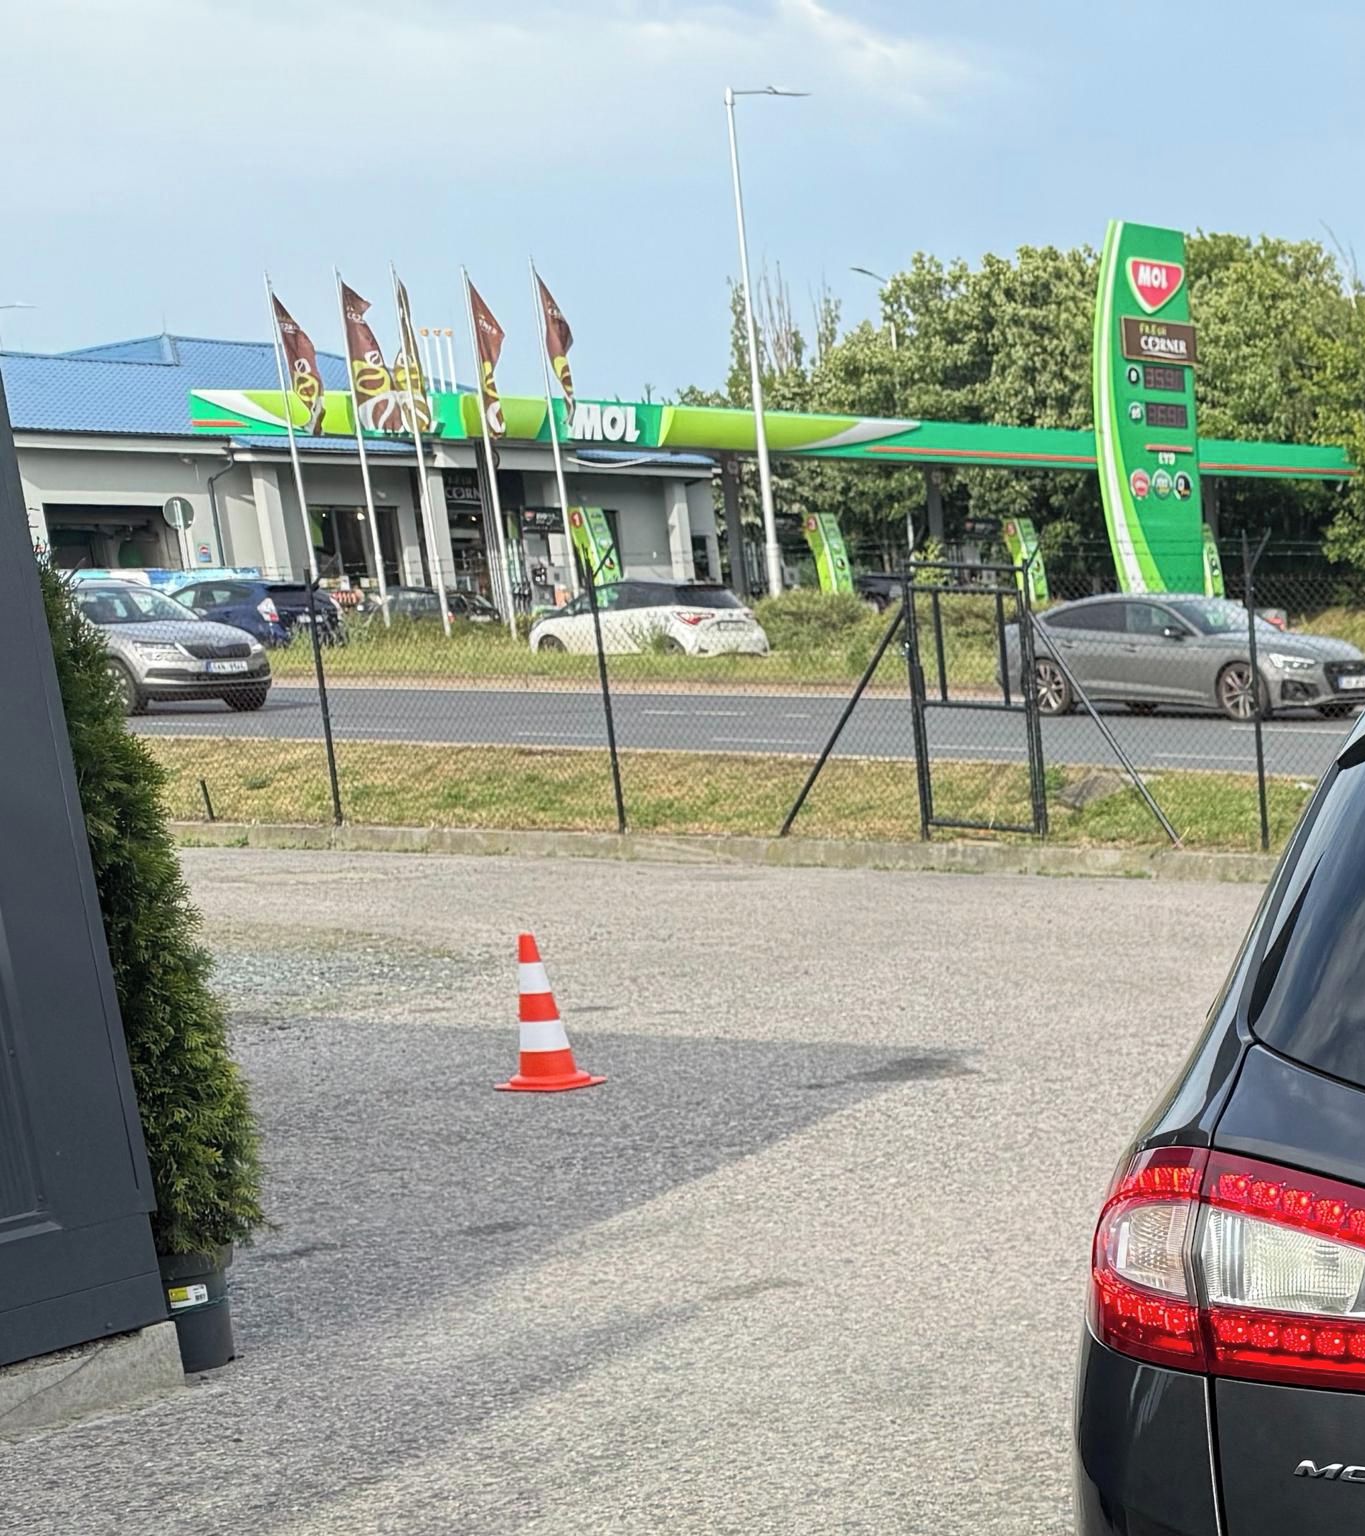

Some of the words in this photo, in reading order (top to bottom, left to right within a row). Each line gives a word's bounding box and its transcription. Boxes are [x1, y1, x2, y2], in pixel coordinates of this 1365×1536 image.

[1137, 263, 1168, 289] MOL
[1140, 335, 1187, 354] CORNER
[567, 402, 640, 443] MOL
